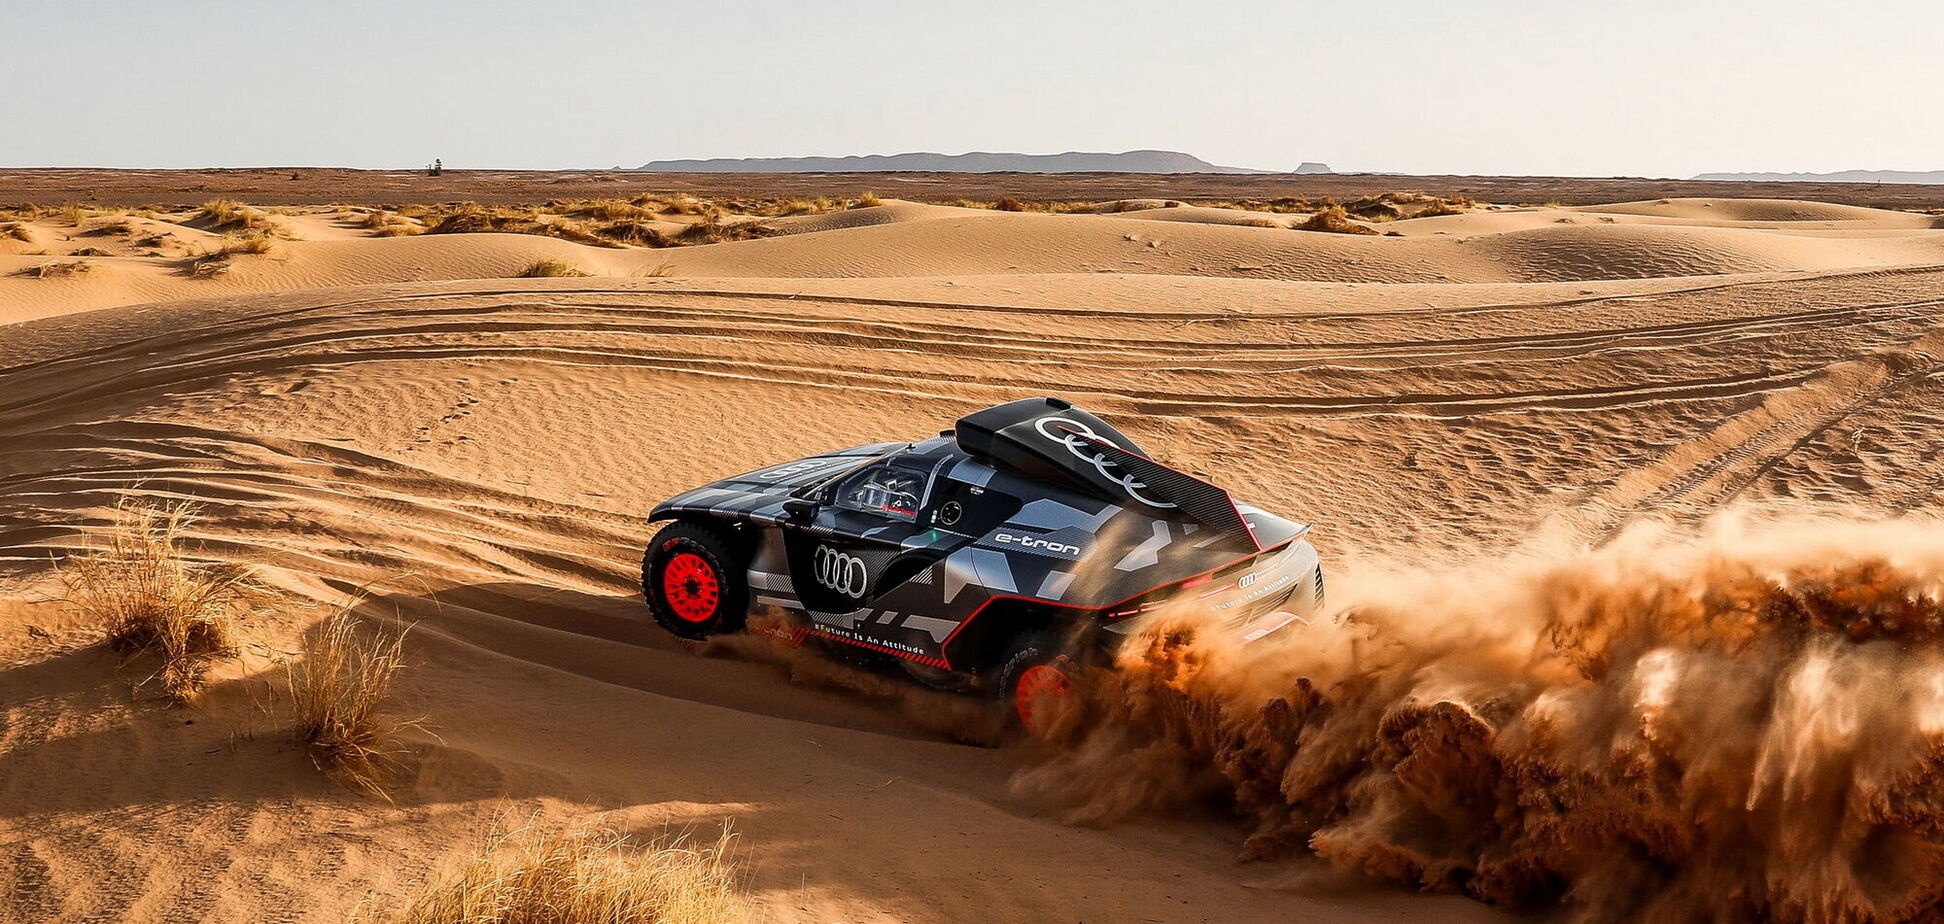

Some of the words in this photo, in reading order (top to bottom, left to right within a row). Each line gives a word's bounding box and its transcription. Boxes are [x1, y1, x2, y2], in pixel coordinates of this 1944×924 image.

[995, 533, 1080, 556] e-tron
[814, 624, 851, 638] #Future
[853, 632, 863, 641] Is
[866, 635, 879, 645] An
[882, 640, 925, 655] Attitude
